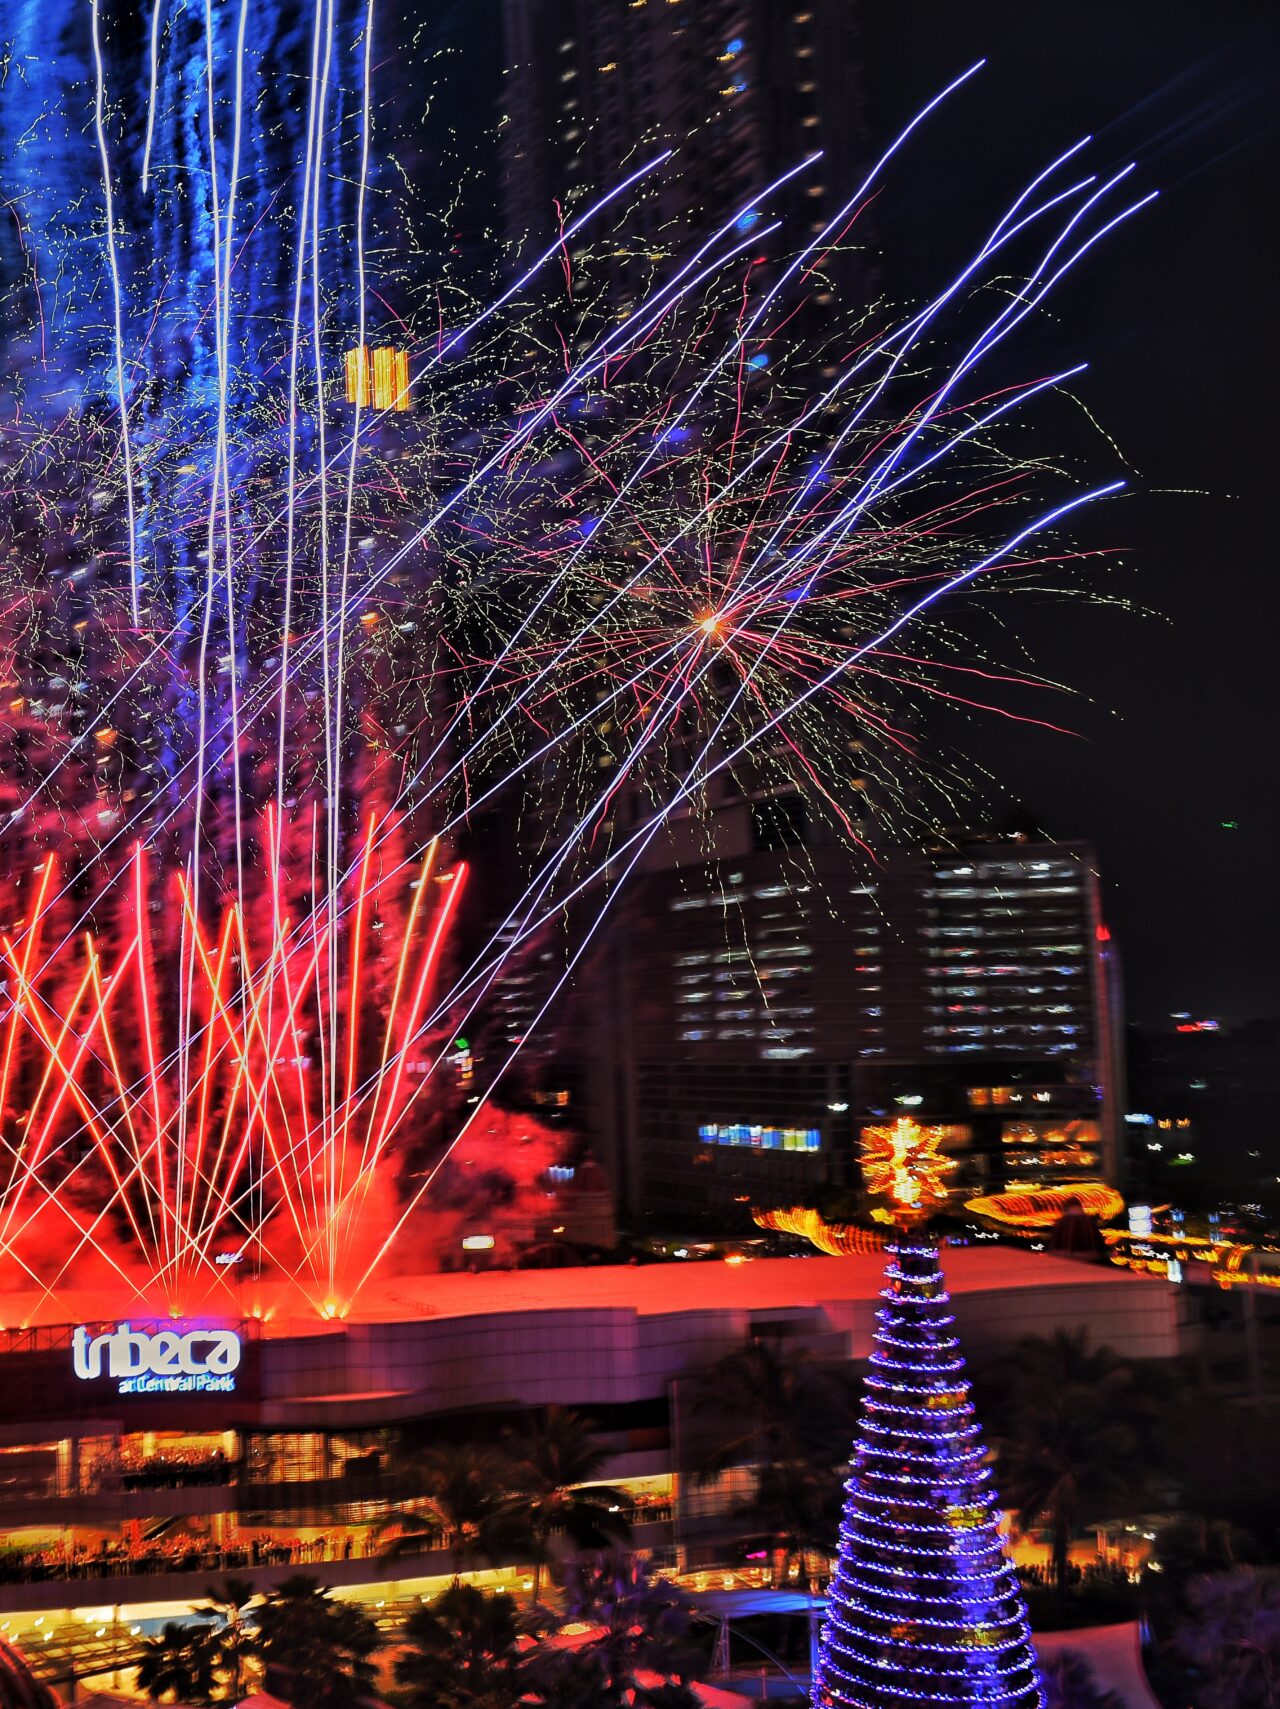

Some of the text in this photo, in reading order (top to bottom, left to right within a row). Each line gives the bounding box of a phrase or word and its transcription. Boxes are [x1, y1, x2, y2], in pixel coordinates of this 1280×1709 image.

[72, 1323, 241, 1379] tribeca
[137, 1374, 195, 1392] Central
[196, 1374, 235, 1391] Park
